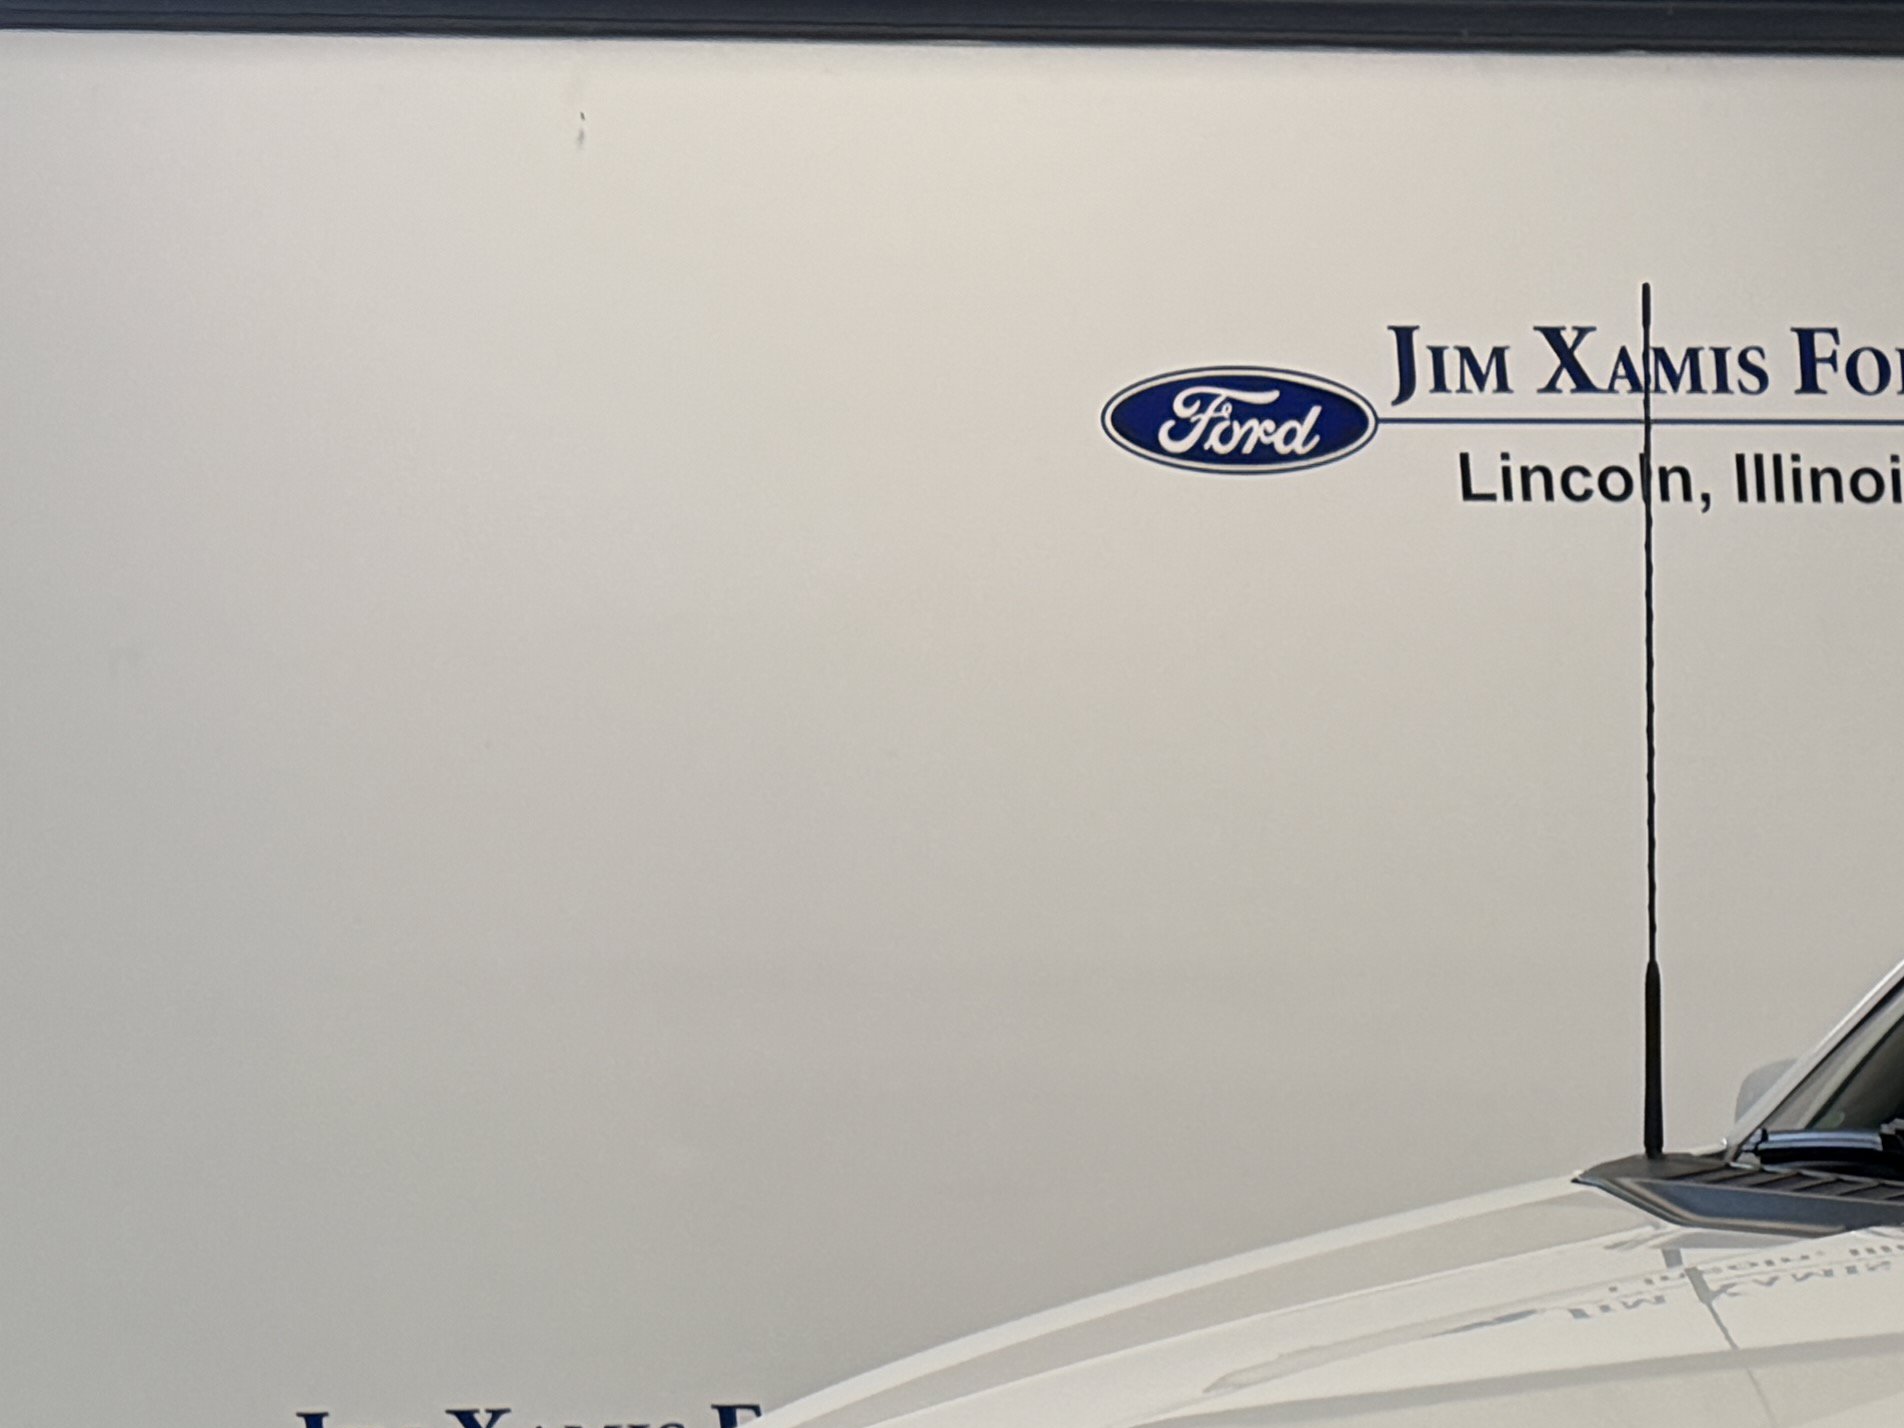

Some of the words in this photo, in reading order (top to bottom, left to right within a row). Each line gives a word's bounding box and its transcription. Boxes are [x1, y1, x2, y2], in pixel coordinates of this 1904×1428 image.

[1387, 324, 1515, 406] JIM
[1532, 324, 1771, 396] XAMIS
[1158, 386, 1321, 456] Ford
[1458, 451, 1712, 514] Lincoln,
